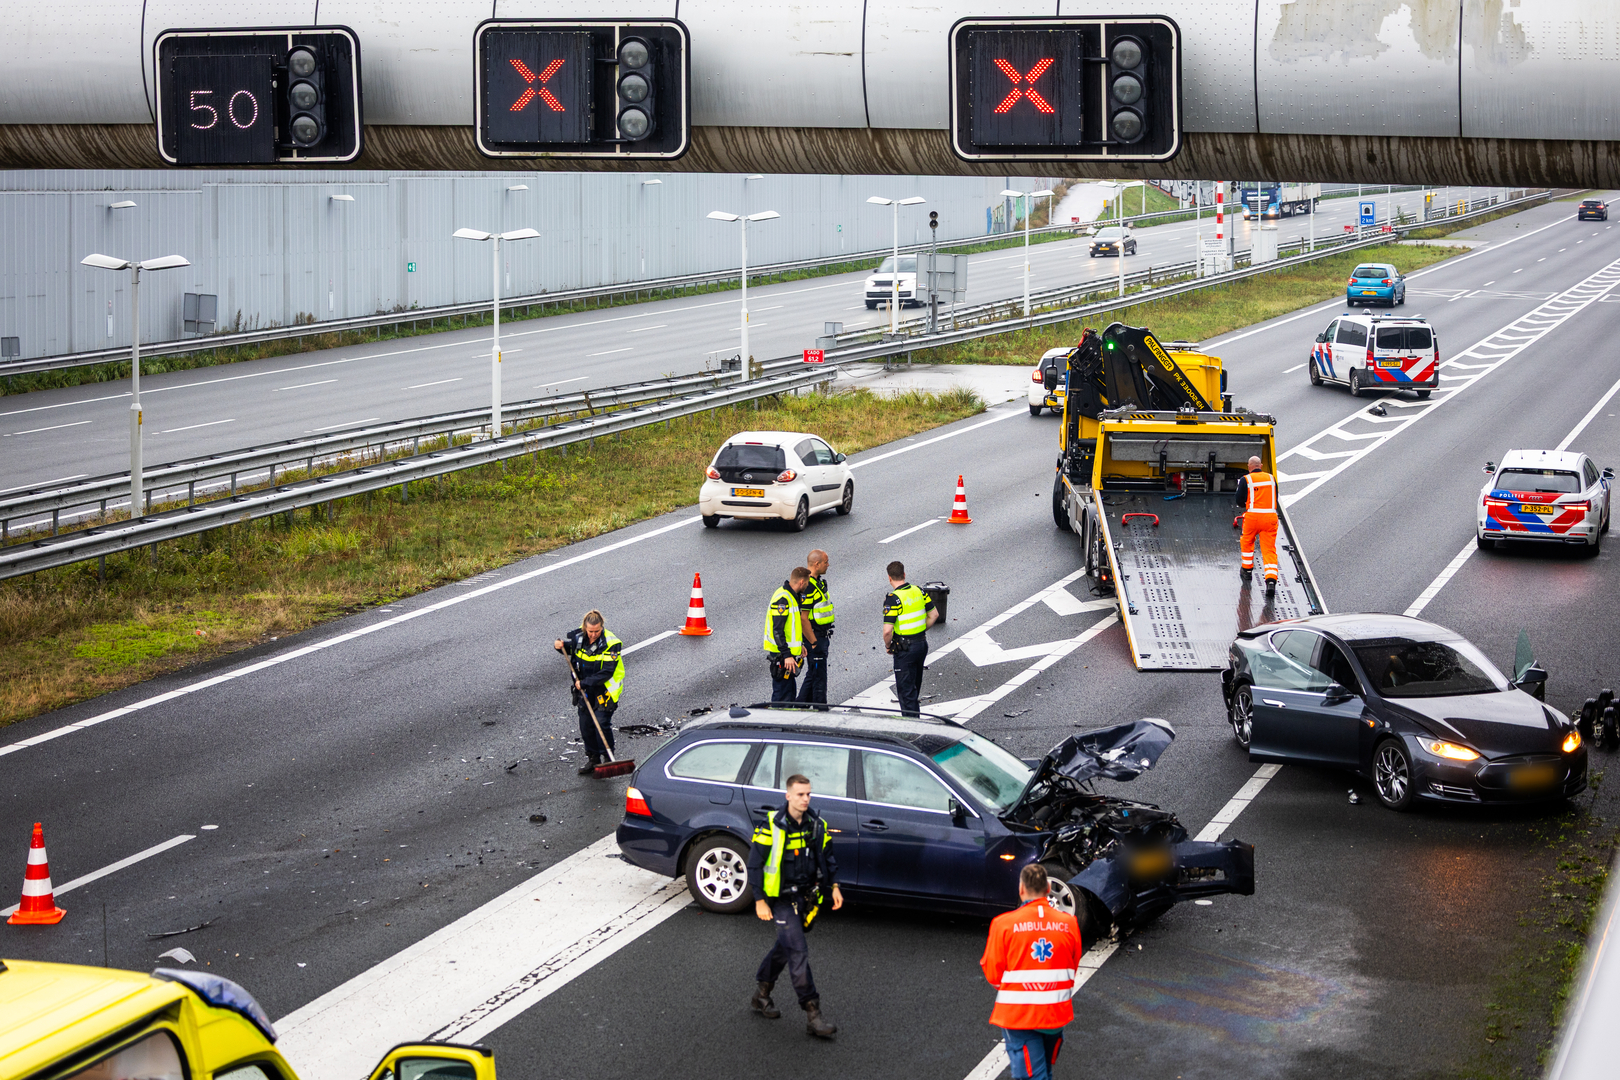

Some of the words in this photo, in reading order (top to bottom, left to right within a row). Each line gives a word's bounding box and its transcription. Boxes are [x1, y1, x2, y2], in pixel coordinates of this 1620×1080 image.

[190, 90, 258, 129] 50
[1145, 337, 1173, 370] PALFINGER
[1173, 372, 1183, 382] PK
[1524, 505, 1551, 513] P-352-PL
[1013, 921, 1069, 933] AMBULANCE
